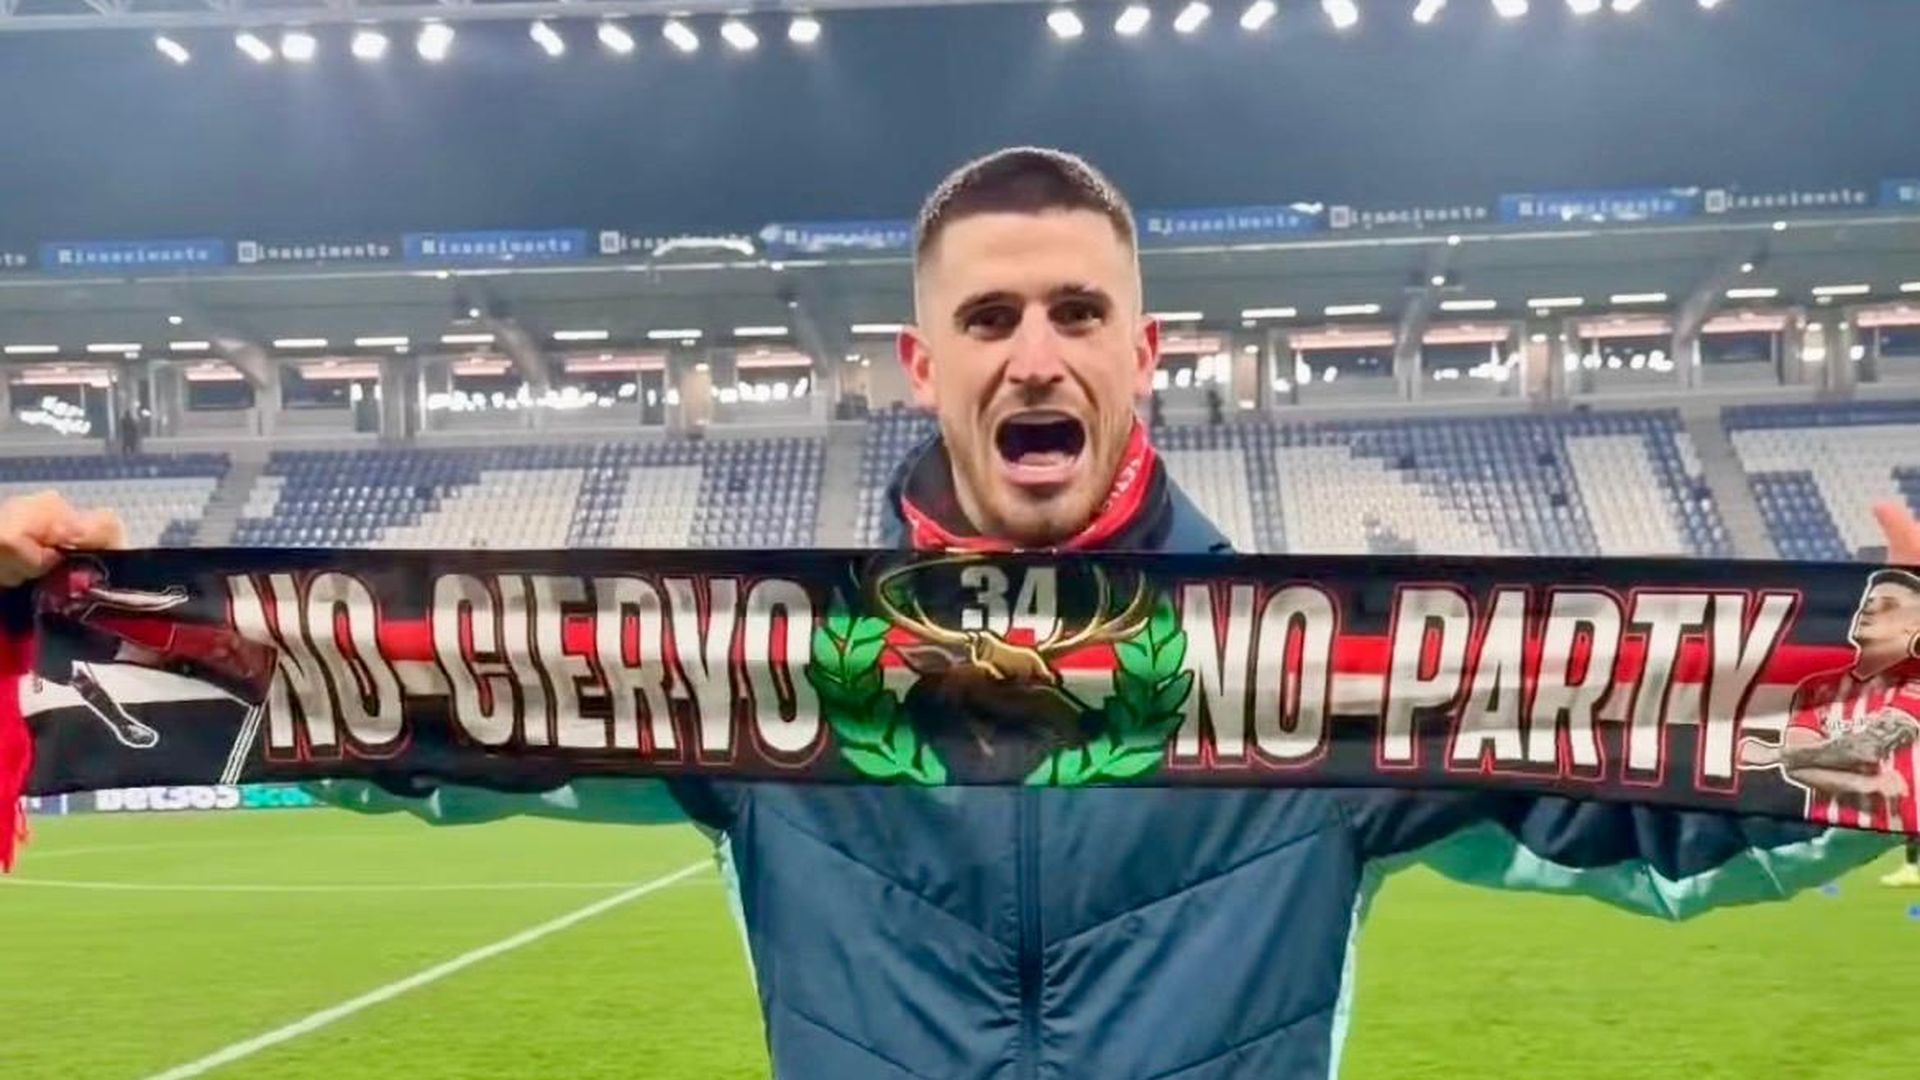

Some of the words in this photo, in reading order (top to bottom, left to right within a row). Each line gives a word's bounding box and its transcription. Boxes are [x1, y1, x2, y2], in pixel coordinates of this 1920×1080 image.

[226, 571, 406, 756] NO
[431, 571, 824, 758] CIERVO
[961, 564, 1059, 645] 34
[1172, 583, 1338, 763] NO
[1380, 586, 1796, 784] PARTY
